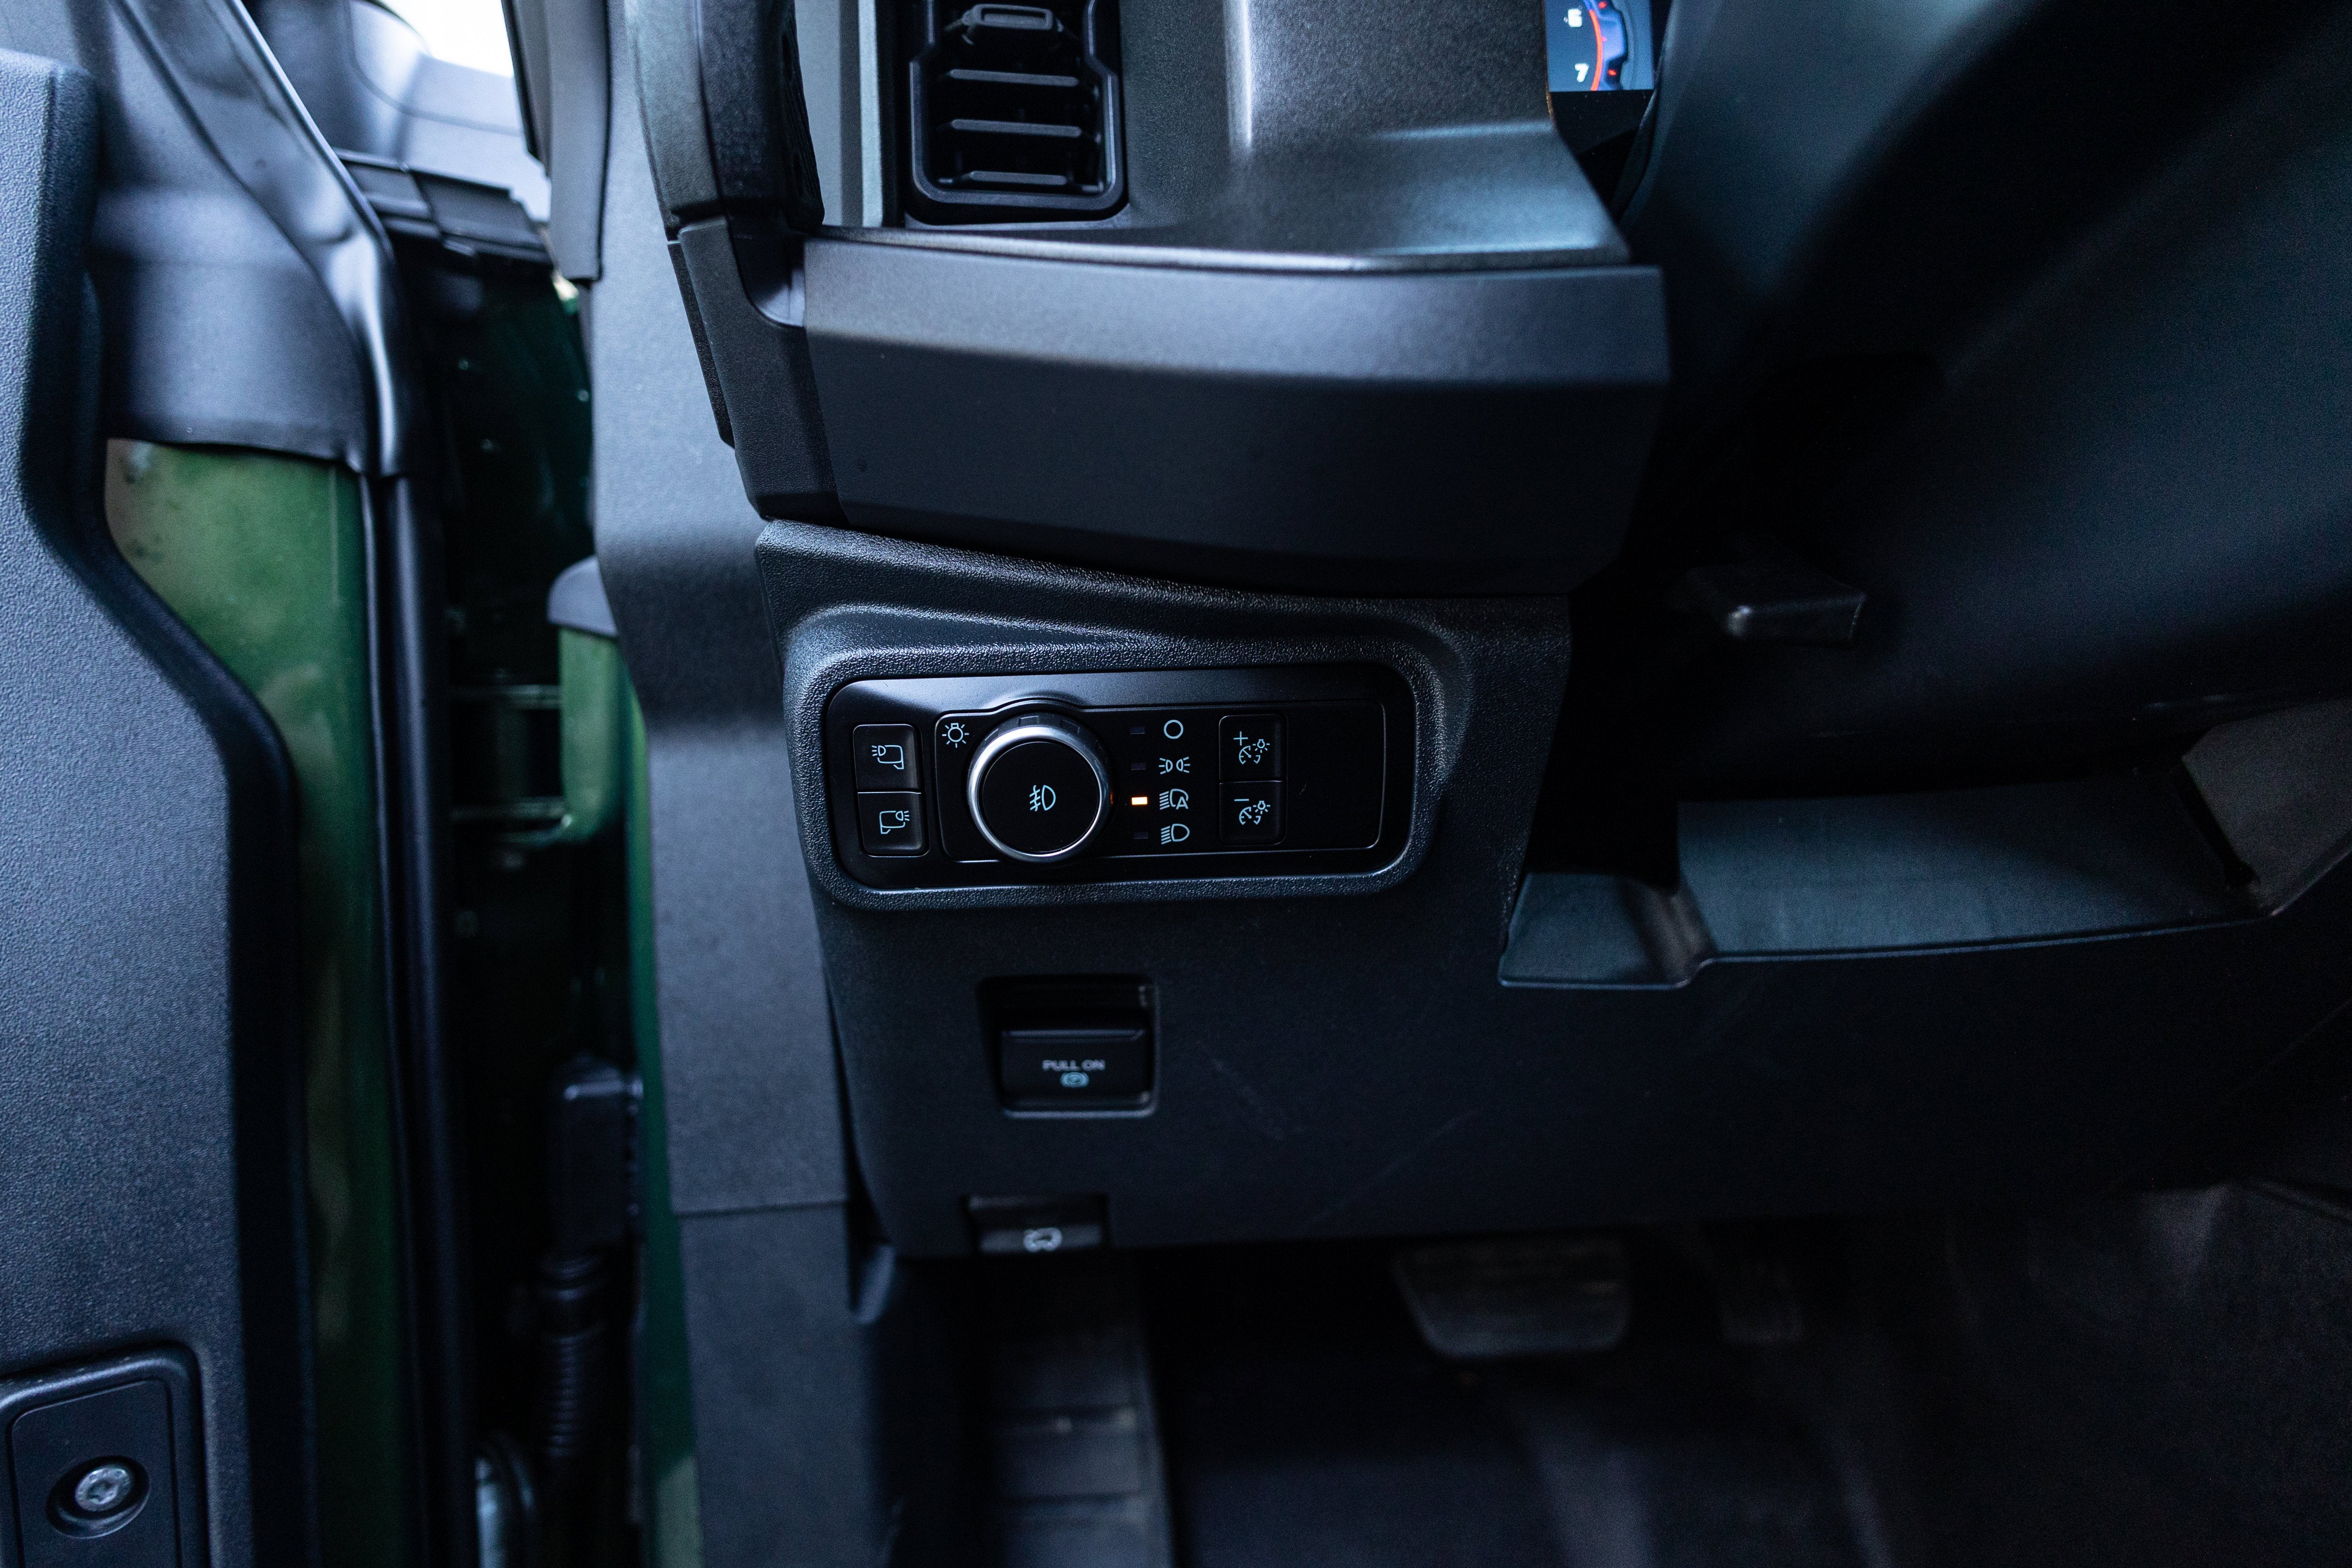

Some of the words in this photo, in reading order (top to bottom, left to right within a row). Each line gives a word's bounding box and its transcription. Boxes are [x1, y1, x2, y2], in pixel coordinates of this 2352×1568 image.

[1574, 63, 1589, 83] 7
[1042, 1060, 1080, 1071] PULL
[1081, 1059, 1105, 1071] ON
